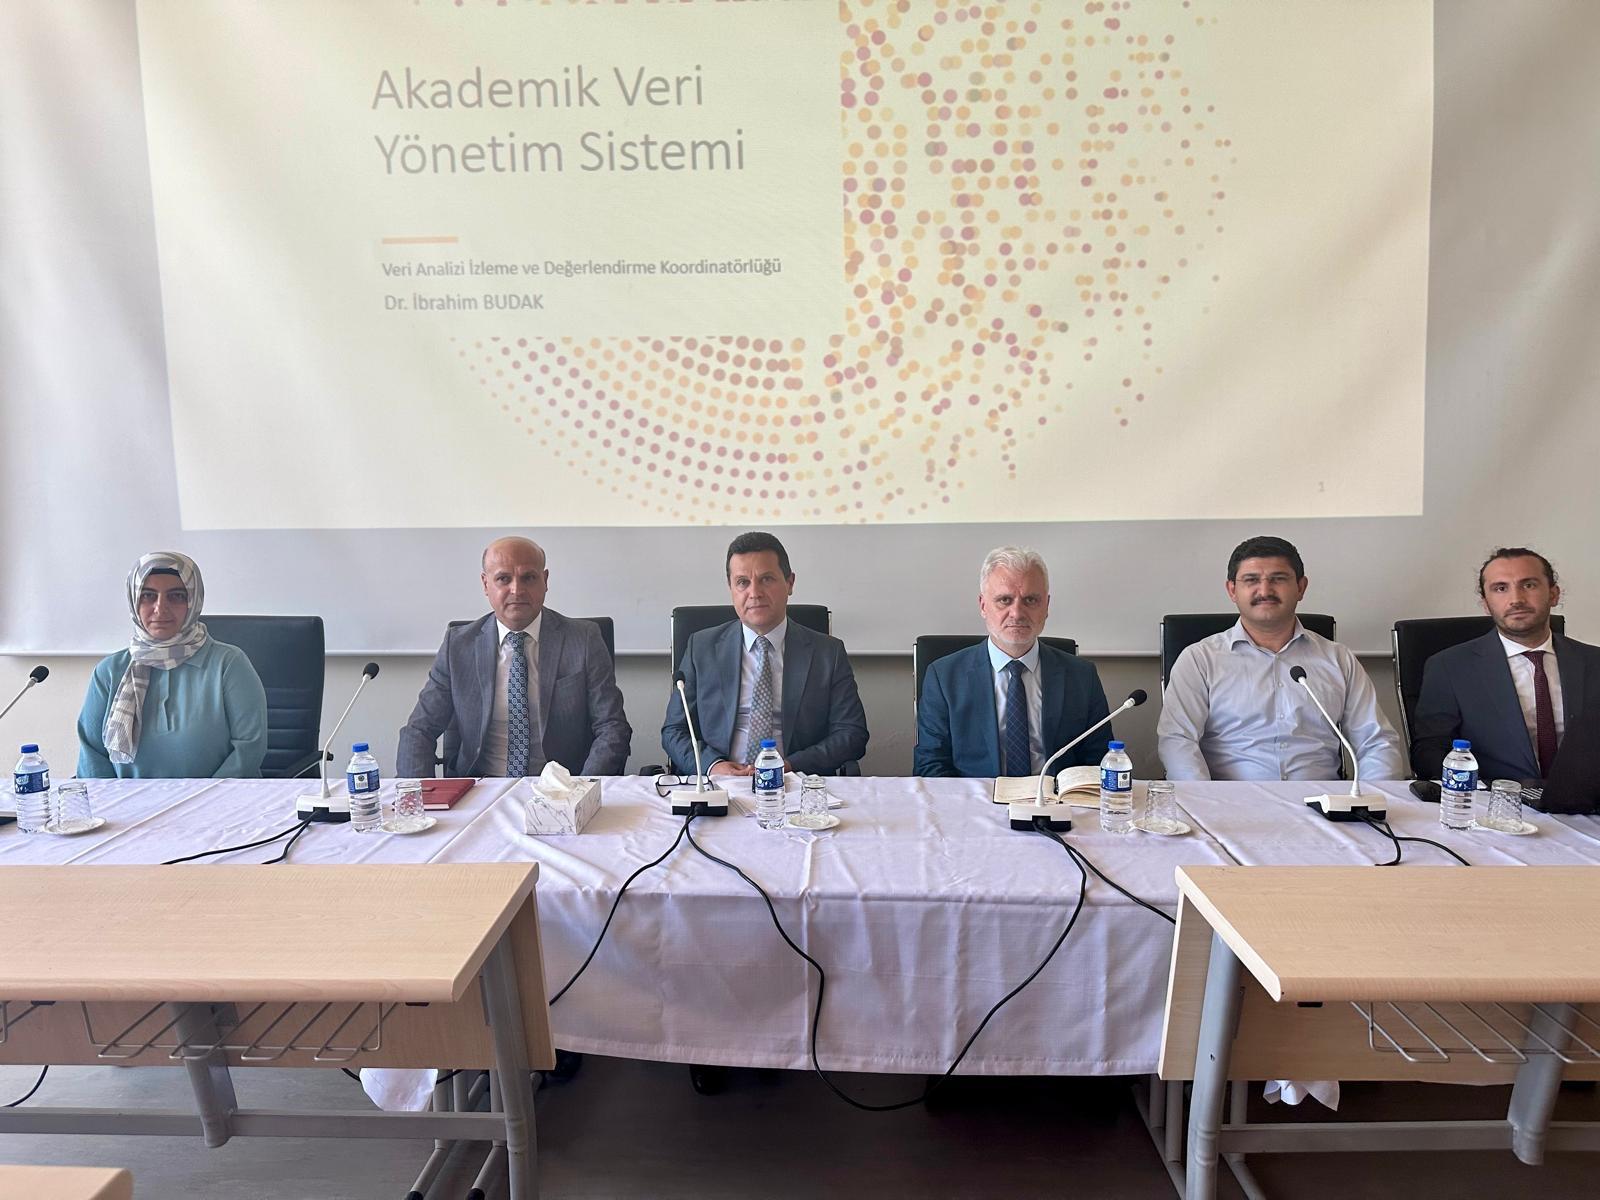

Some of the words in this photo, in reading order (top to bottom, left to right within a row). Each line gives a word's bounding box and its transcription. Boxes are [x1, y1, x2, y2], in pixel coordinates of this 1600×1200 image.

[372, 64, 600, 110] Akademik
[613, 64, 703, 107] Veri
[374, 131, 563, 174] Yönetim
[580, 128, 744, 172] Sistemi
[381, 262, 412, 277] Veri
[416, 261, 465, 277] Analizi
[469, 259, 519, 277] İzleme
[521, 264, 540, 275] ve
[544, 259, 657, 279] Değerlendirme
[660, 257, 782, 277] Koordinatörlüğü
[384, 295, 408, 311] Dr.
[413, 293, 478, 311] İbrahim
[483, 294, 544, 310] BUDAK
